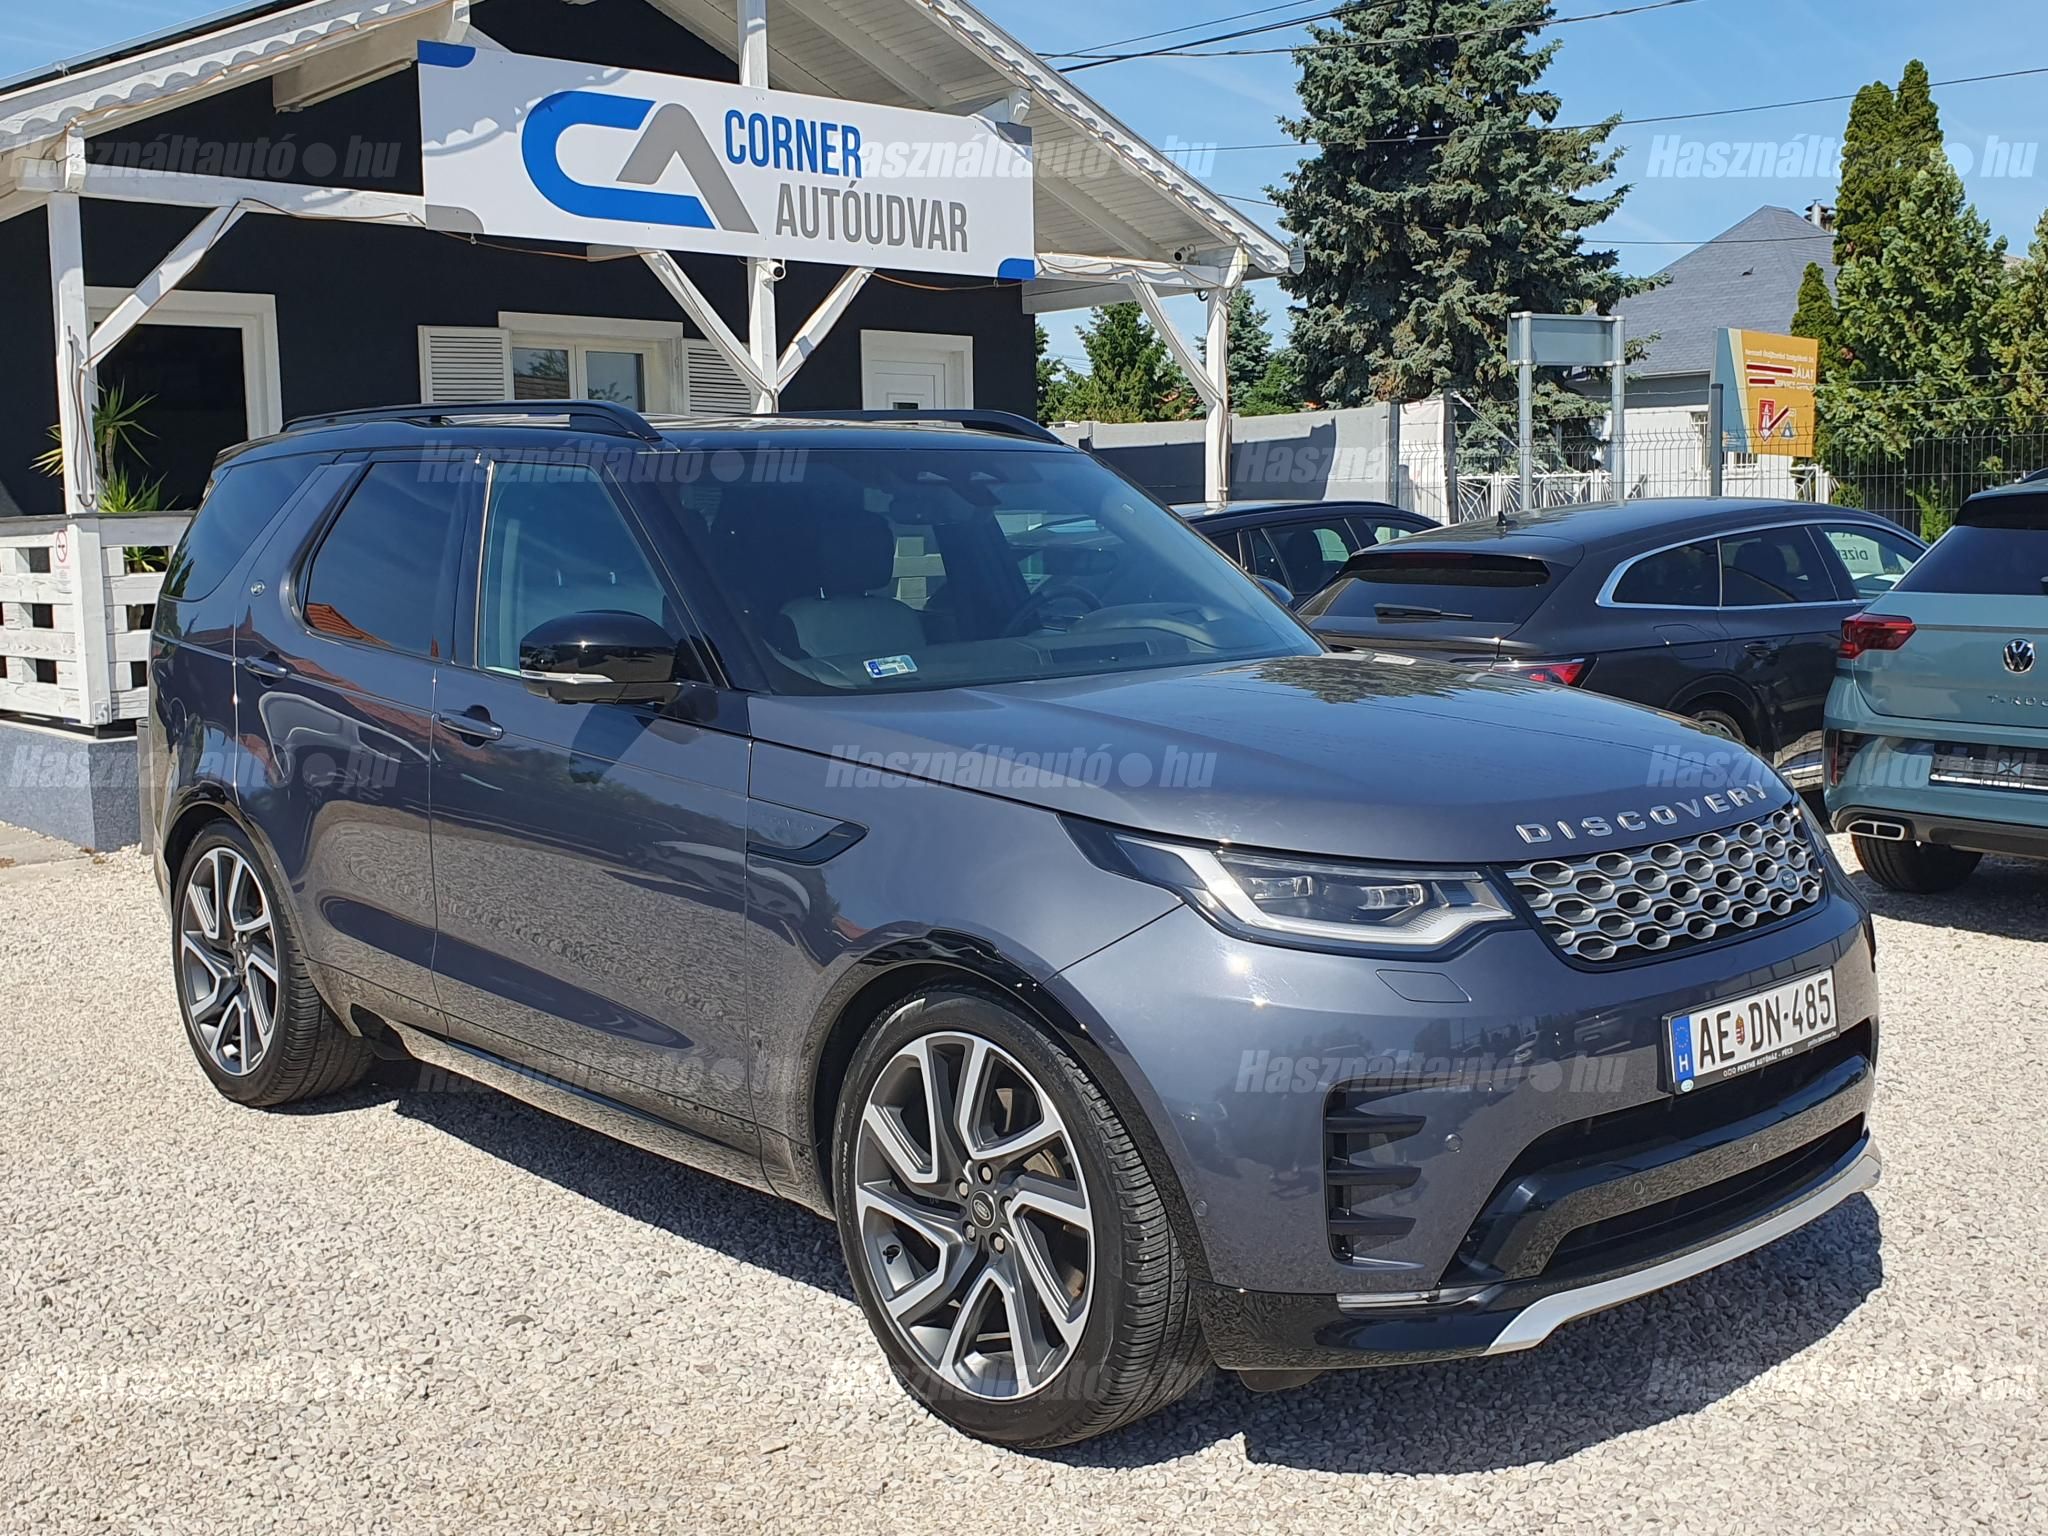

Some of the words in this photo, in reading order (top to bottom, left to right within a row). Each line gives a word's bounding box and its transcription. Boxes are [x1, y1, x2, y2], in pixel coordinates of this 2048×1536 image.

[724, 108, 863, 179] CORNER
[774, 179, 969, 254] AUTÓUDVAR
[1514, 780, 1767, 845] DISCOVERY
[1678, 1053, 1690, 1073] H
[1698, 1010, 1736, 1070] AE
